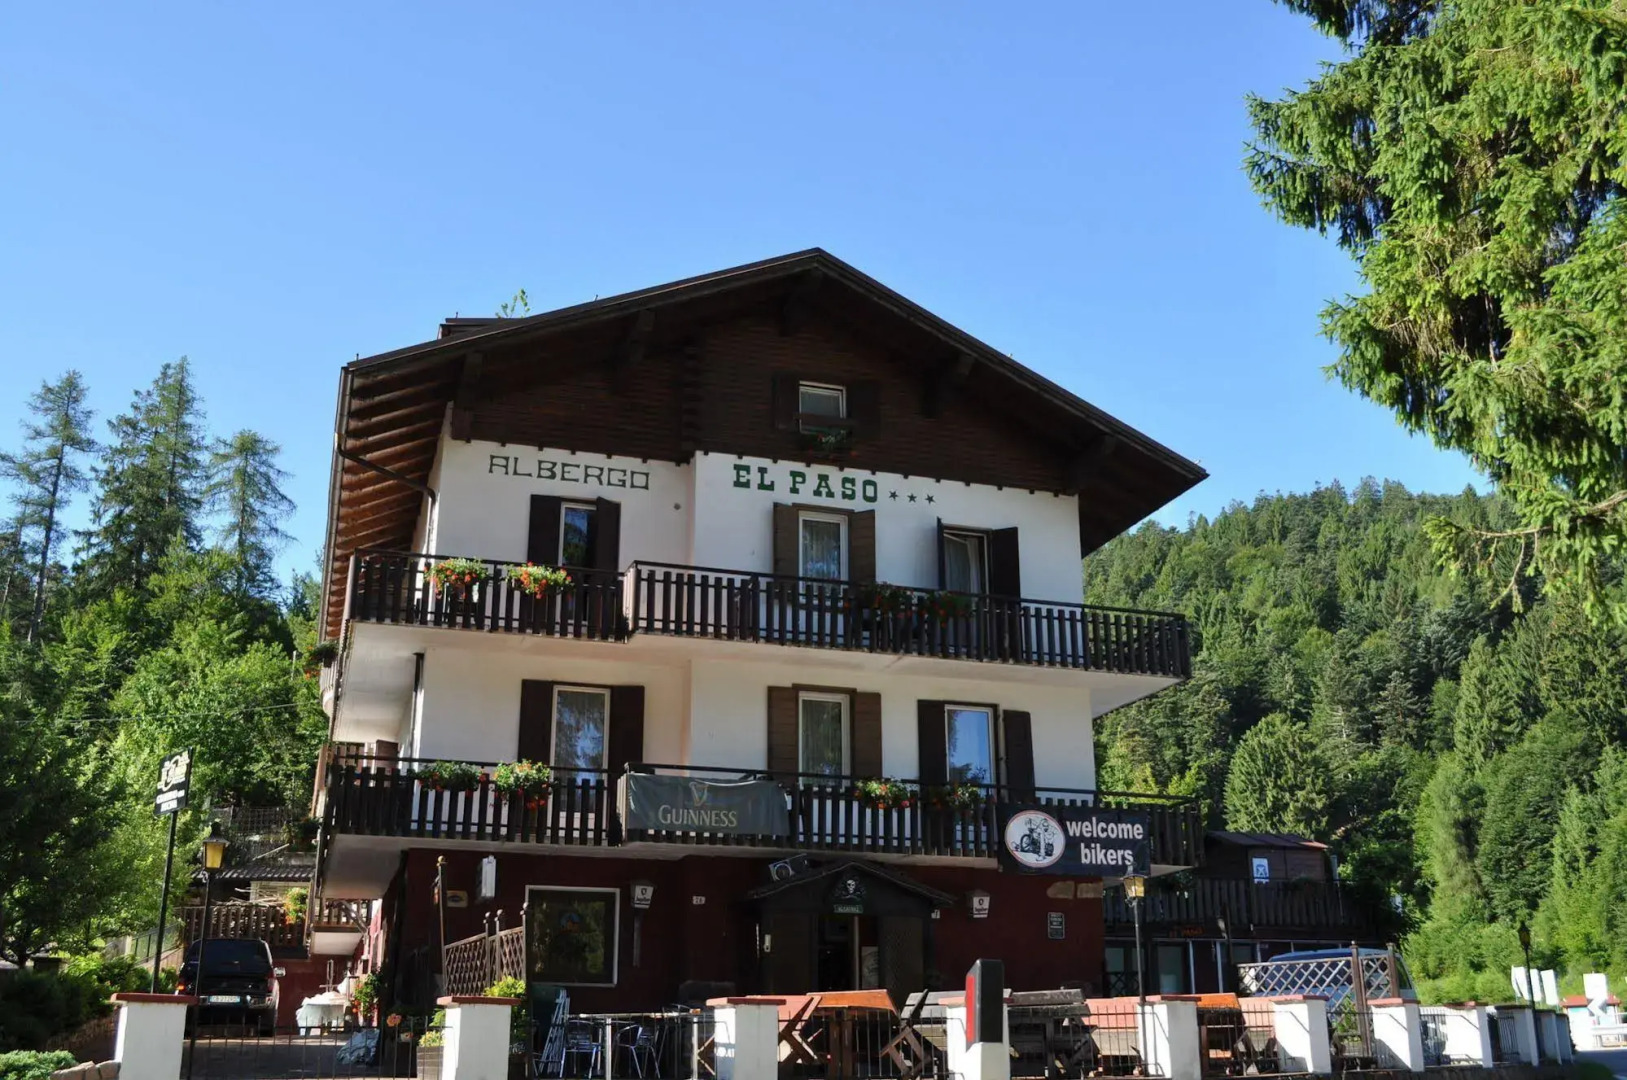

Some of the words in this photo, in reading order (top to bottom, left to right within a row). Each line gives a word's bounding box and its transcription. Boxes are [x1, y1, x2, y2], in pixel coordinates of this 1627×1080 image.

[488, 454, 650, 490] ALBERGO
[733, 463, 775, 492] EL
[789, 470, 878, 503] PASO
[658, 804, 738, 827] GUINNESS
[1066, 816, 1144, 840] welcome
[1080, 842, 1134, 866] bikers
